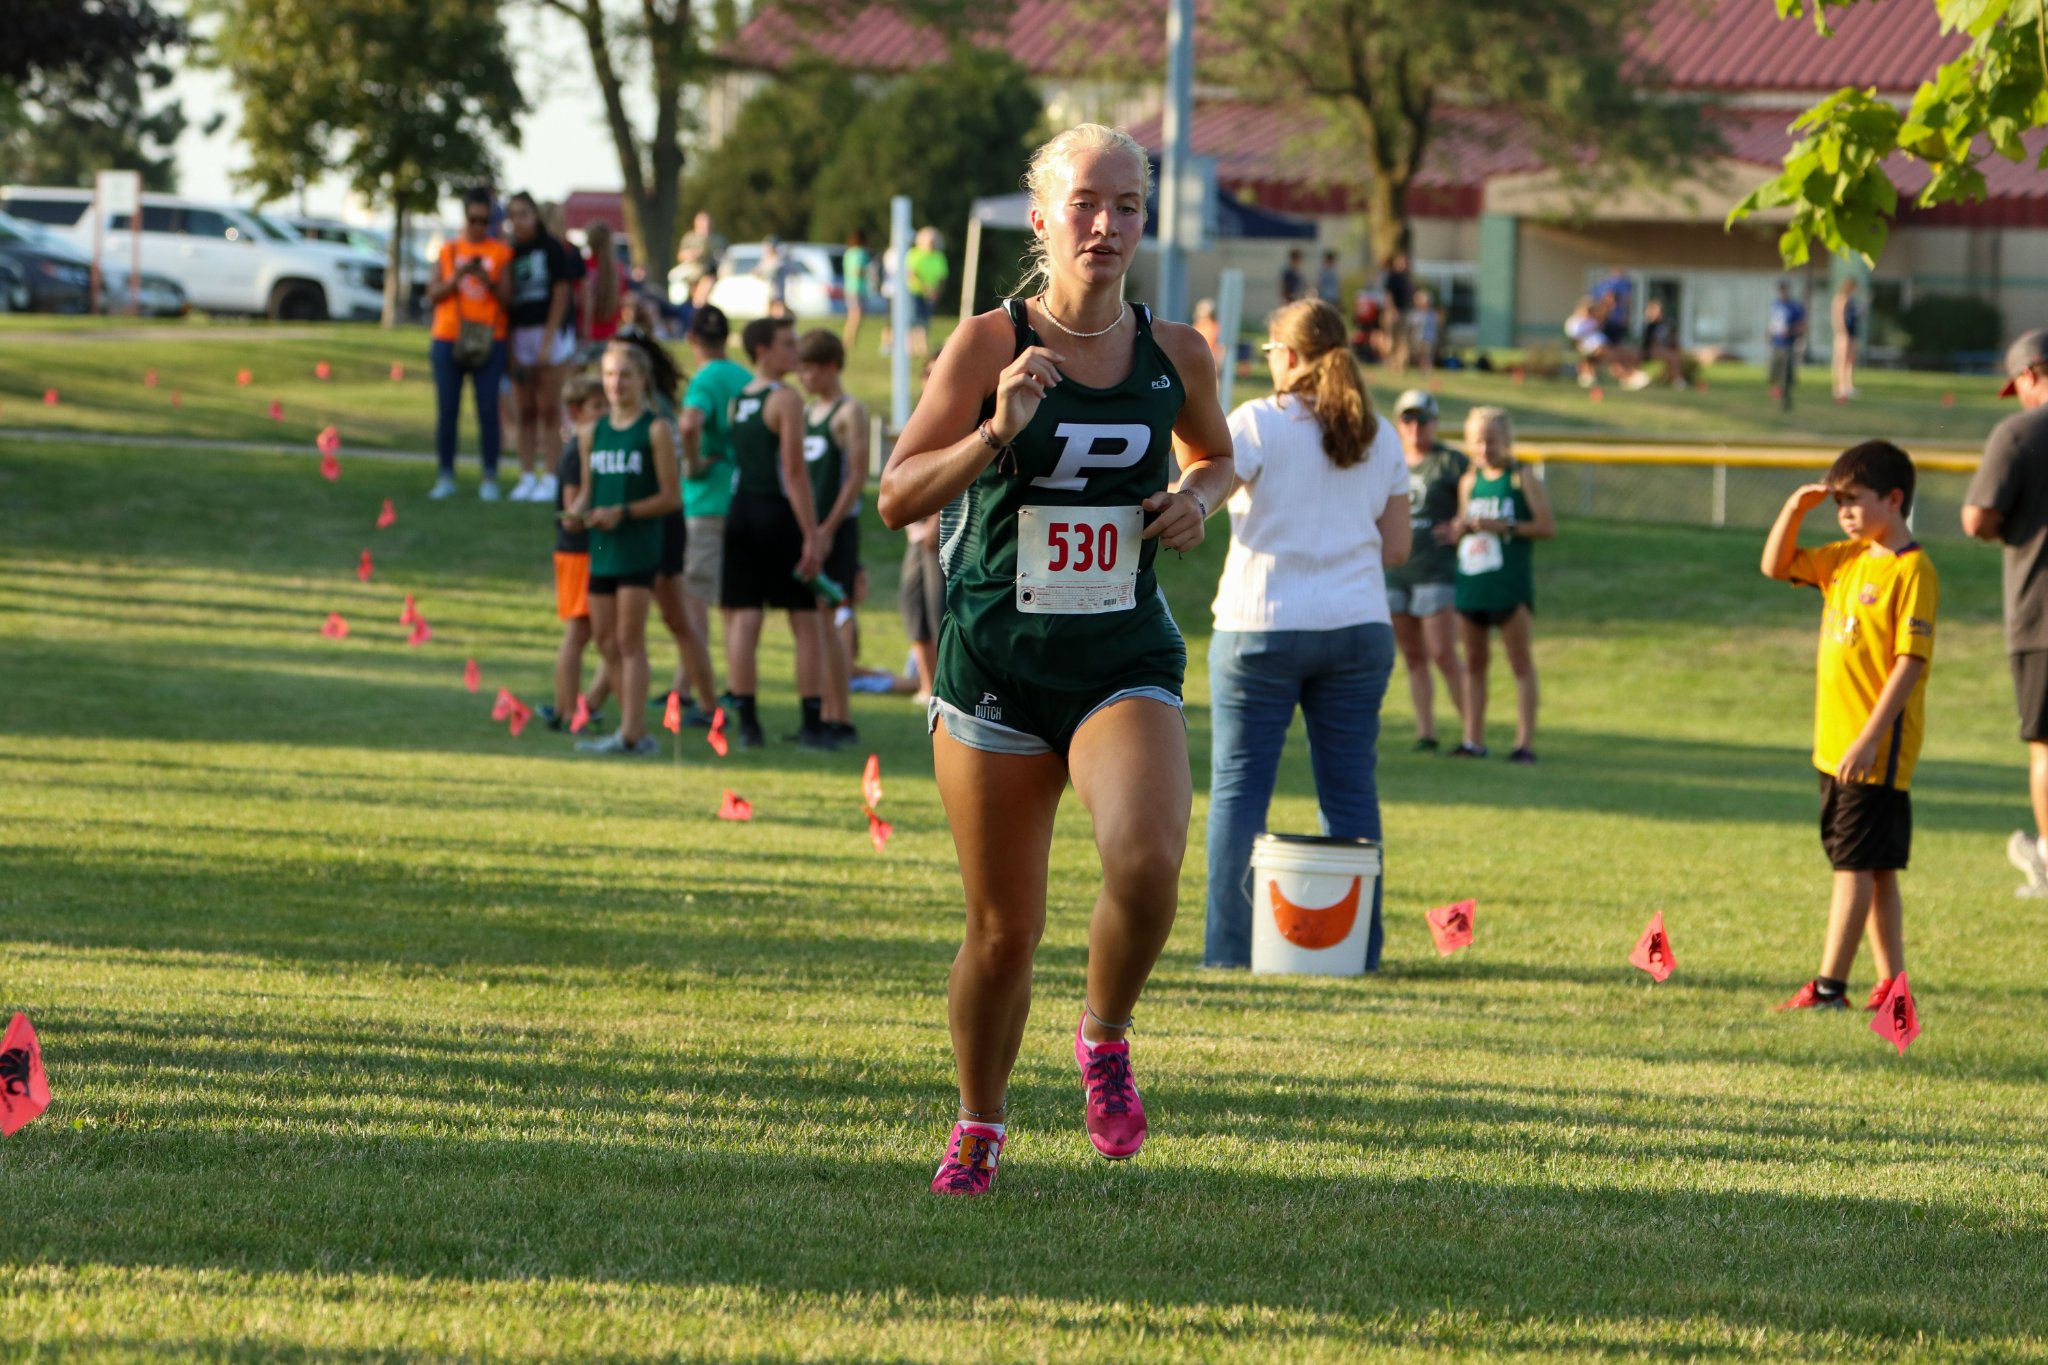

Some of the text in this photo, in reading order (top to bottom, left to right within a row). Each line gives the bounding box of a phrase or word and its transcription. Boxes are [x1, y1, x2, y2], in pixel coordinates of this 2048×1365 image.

[1029, 422, 1152, 492] P
[1048, 522, 1118, 572] 530
[975, 704, 1002, 720] DUTCH
[980, 692, 998, 704] P
